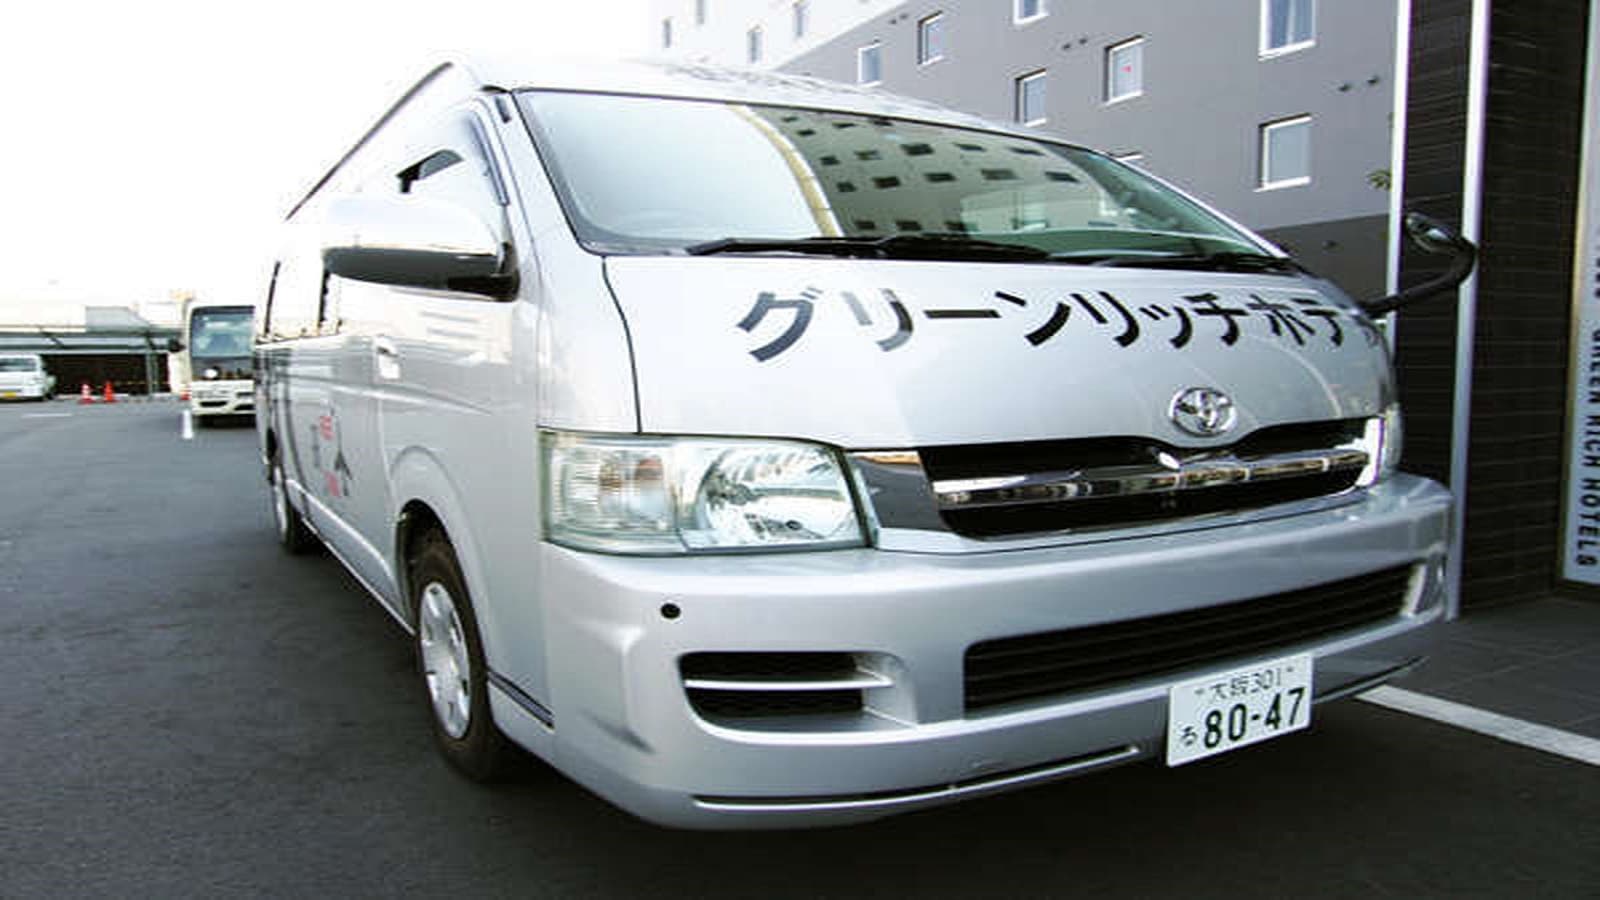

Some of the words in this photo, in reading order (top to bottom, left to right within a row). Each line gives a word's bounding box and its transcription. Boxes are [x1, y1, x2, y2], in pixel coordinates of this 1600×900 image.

[735, 286, 1377, 363] グリーンリッチホテ
[1204, 687, 1305, 748] 80-47
